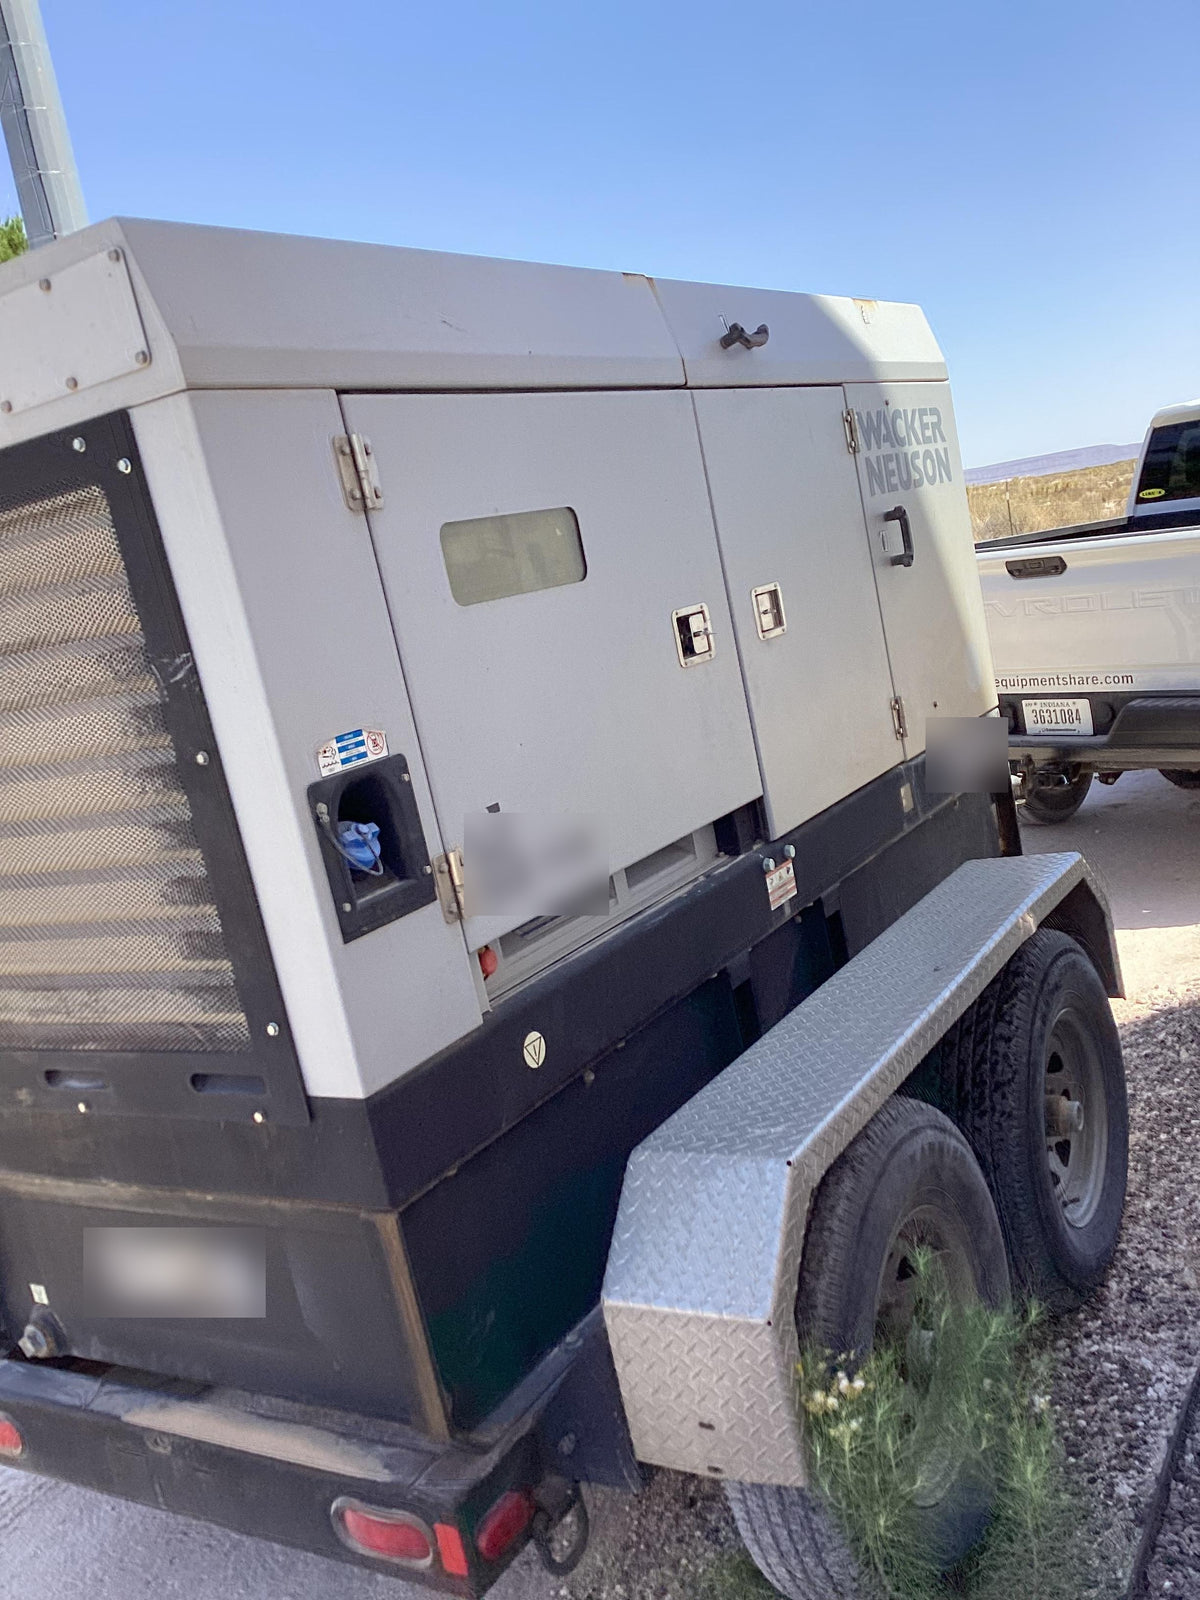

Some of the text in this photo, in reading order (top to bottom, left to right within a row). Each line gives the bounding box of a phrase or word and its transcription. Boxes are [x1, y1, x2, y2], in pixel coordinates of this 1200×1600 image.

[856, 407, 946, 451] WACKER
[865, 447, 952, 497] NEUSON
[995, 674, 1134, 689] equipmentshare.com
[1031, 708, 1082, 725] 3631084
